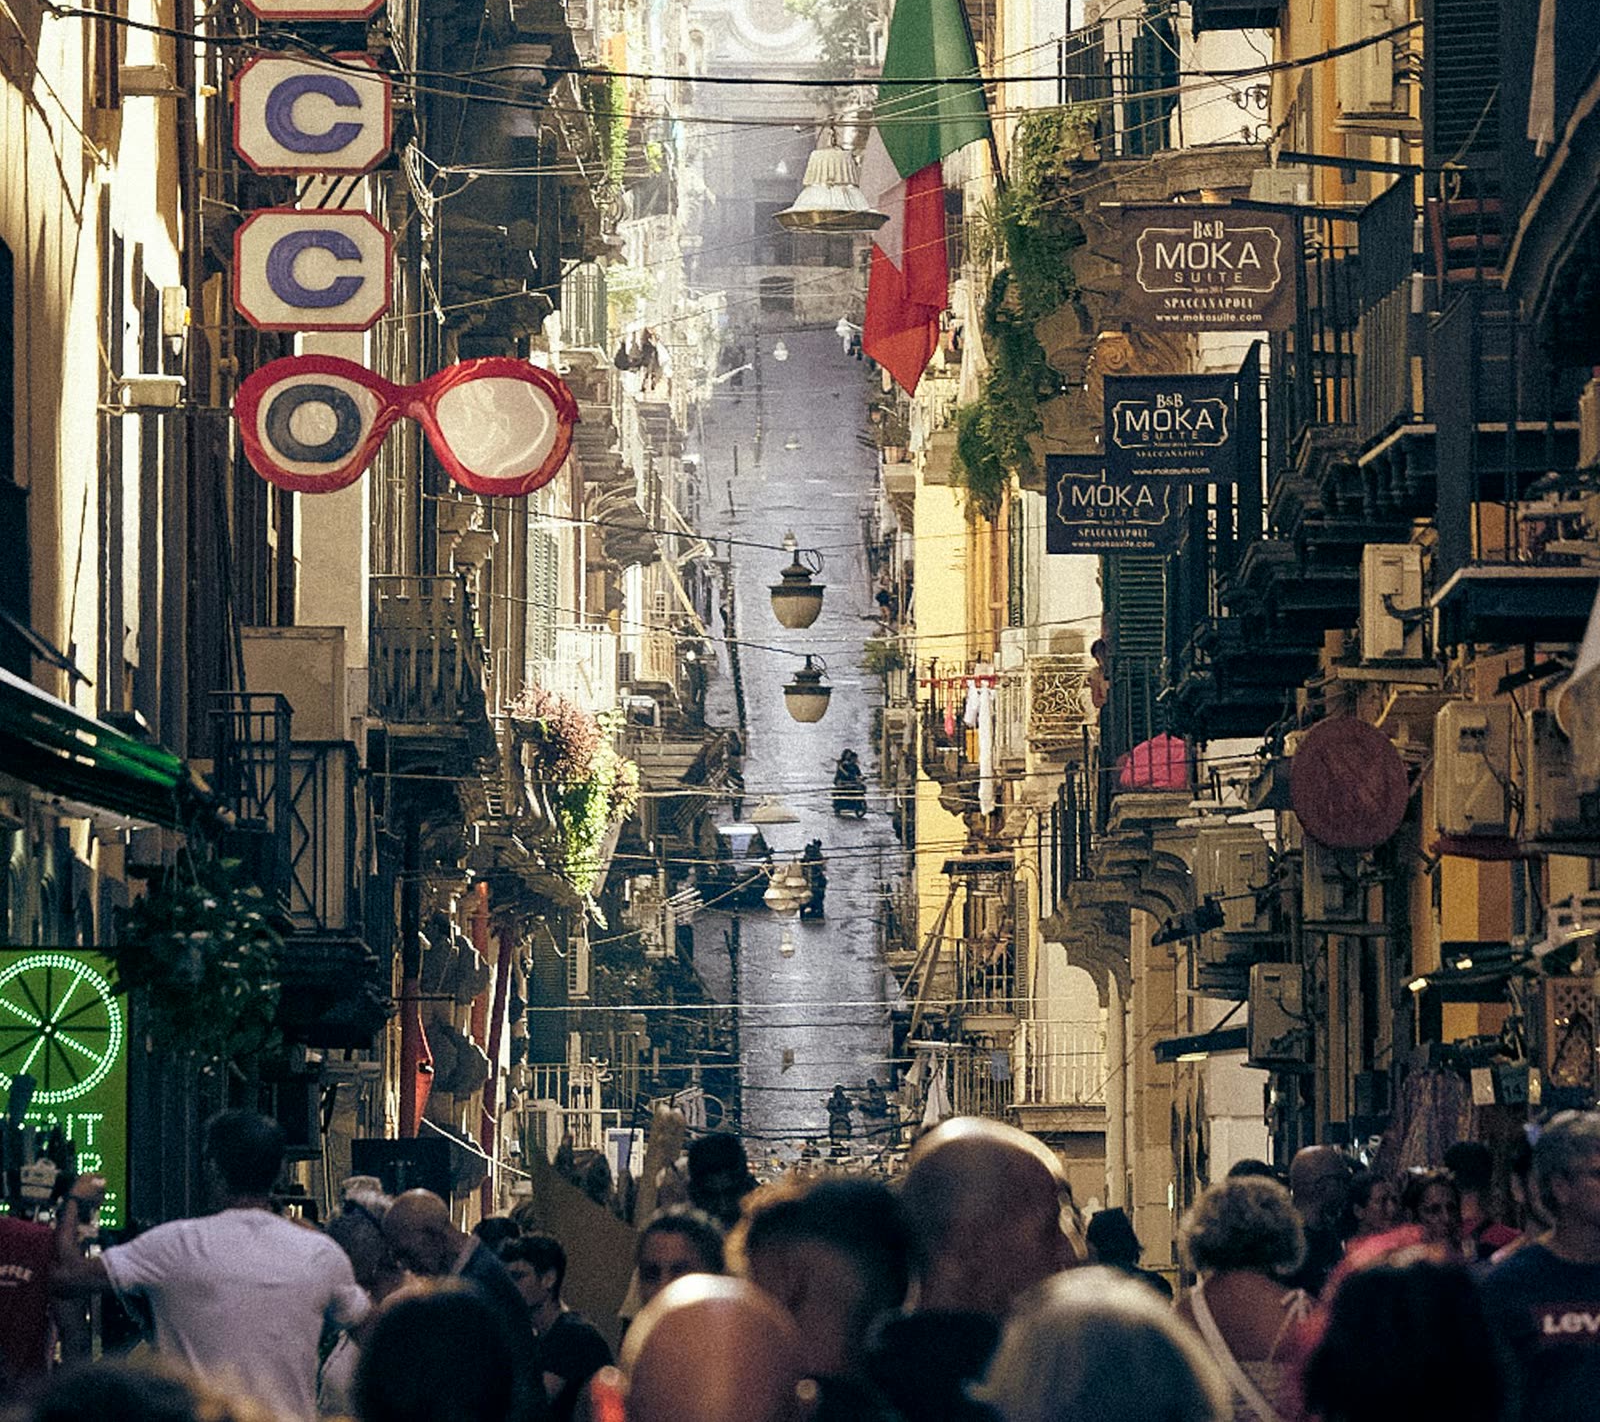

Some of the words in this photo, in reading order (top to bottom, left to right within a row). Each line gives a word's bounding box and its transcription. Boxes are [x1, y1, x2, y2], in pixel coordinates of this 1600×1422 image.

[1193, 220, 1224, 239] B&B
[1155, 241, 1261, 270] MOKA
[1174, 271, 1243, 283] SUITE
[1164, 297, 1253, 309] SPACCANAPOLI
[1156, 312, 1263, 322] www.mokasuite.com
[1156, 393, 1184, 409] B&B
[1125, 408, 1215, 431] MOKA
[1141, 431, 1199, 440] SUITE
[1072, 485, 1154, 506] MOKA
[1086, 507, 1140, 517] SUITE
